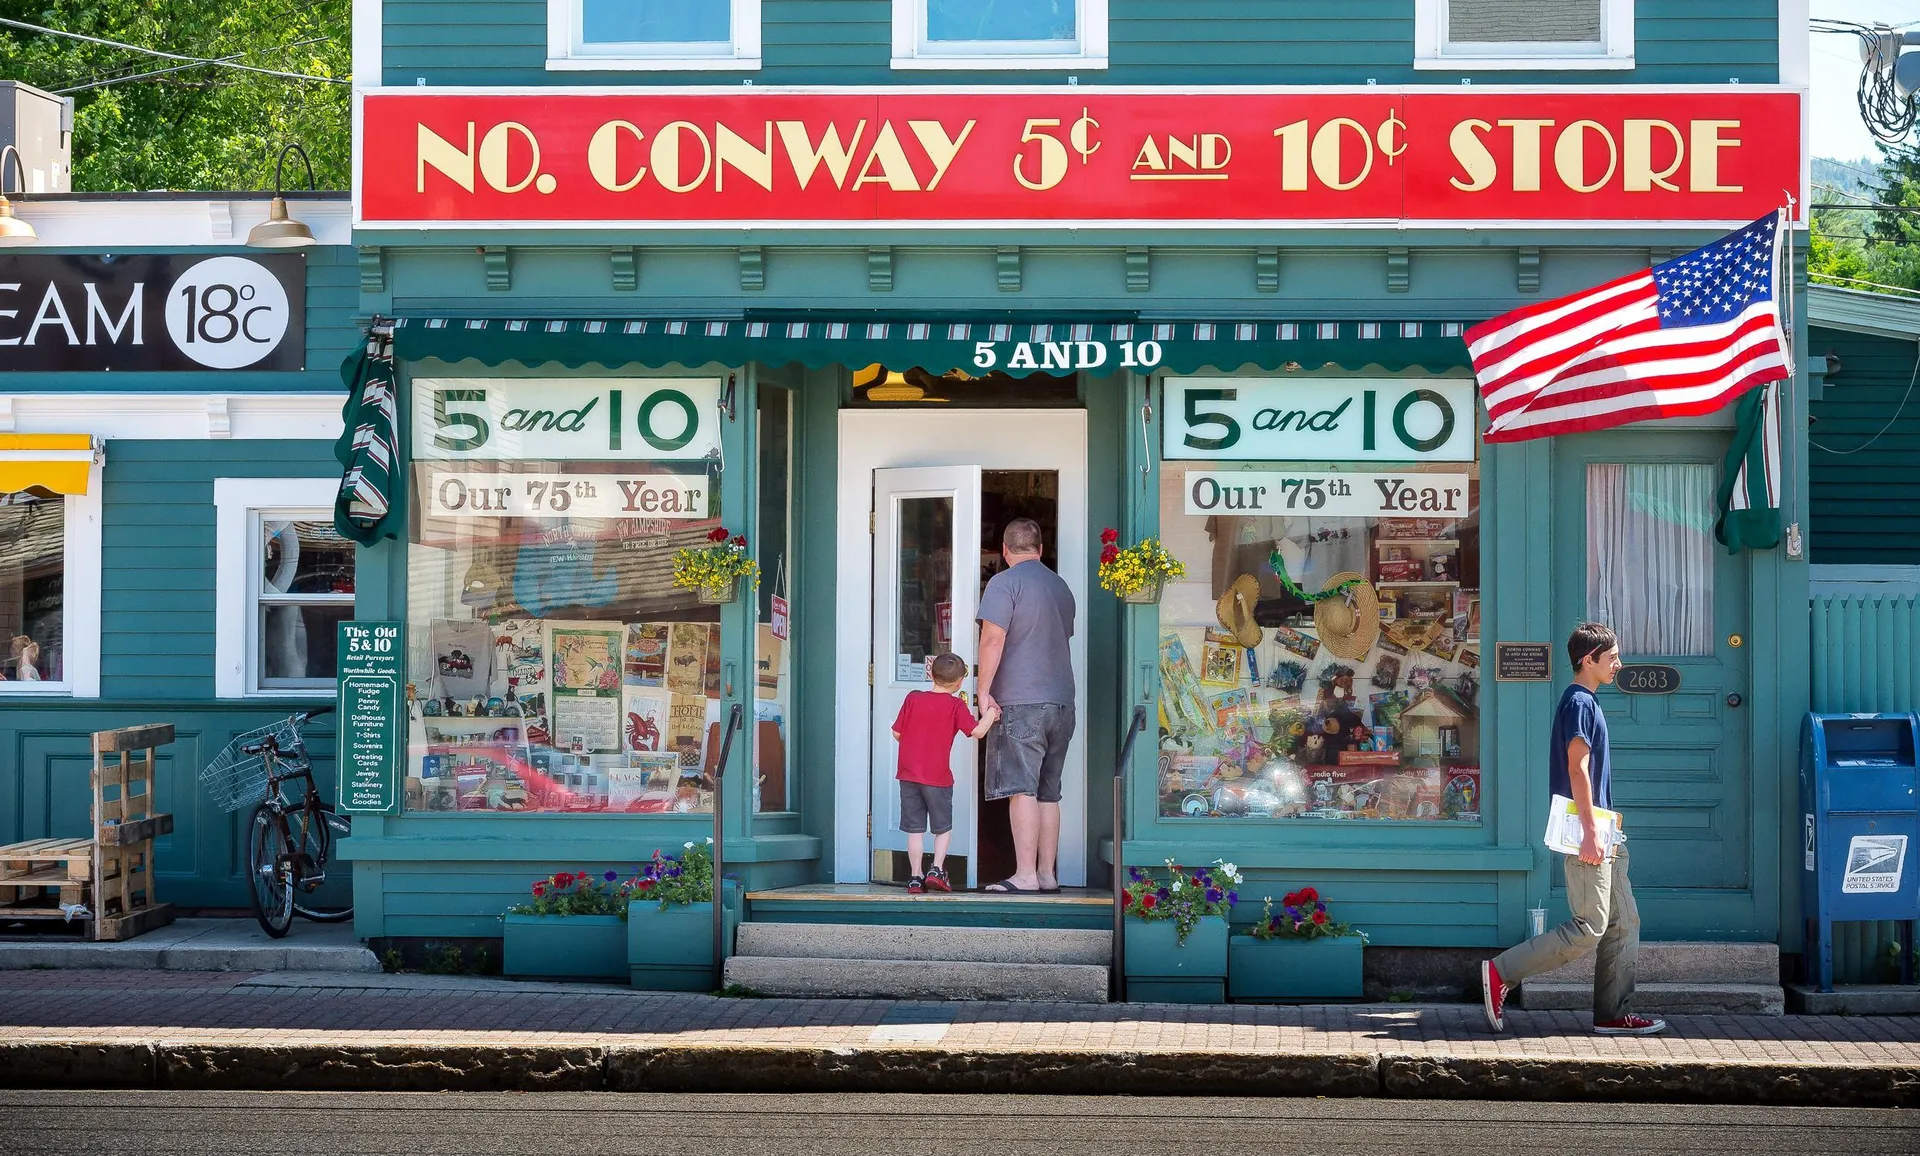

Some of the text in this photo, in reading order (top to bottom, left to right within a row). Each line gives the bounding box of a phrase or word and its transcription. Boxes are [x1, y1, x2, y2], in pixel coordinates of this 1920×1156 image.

[417, 107, 1744, 195] NO. CONWAY 5¢ AND 10¢ STORE
[974, 341, 1162, 369] 5 AND 10
[433, 388, 699, 451] 5 and 10
[1184, 389, 1455, 452] 5 and 10
[439, 479, 701, 512] Our 75th Year
[1192, 478, 1461, 511] Our 75th Year
[543, 525, 571, 546] NORTH
[344, 627, 397, 637] The Old
[350, 638, 391, 652] 5 & 10
[1629, 671, 1668, 688] 2683
